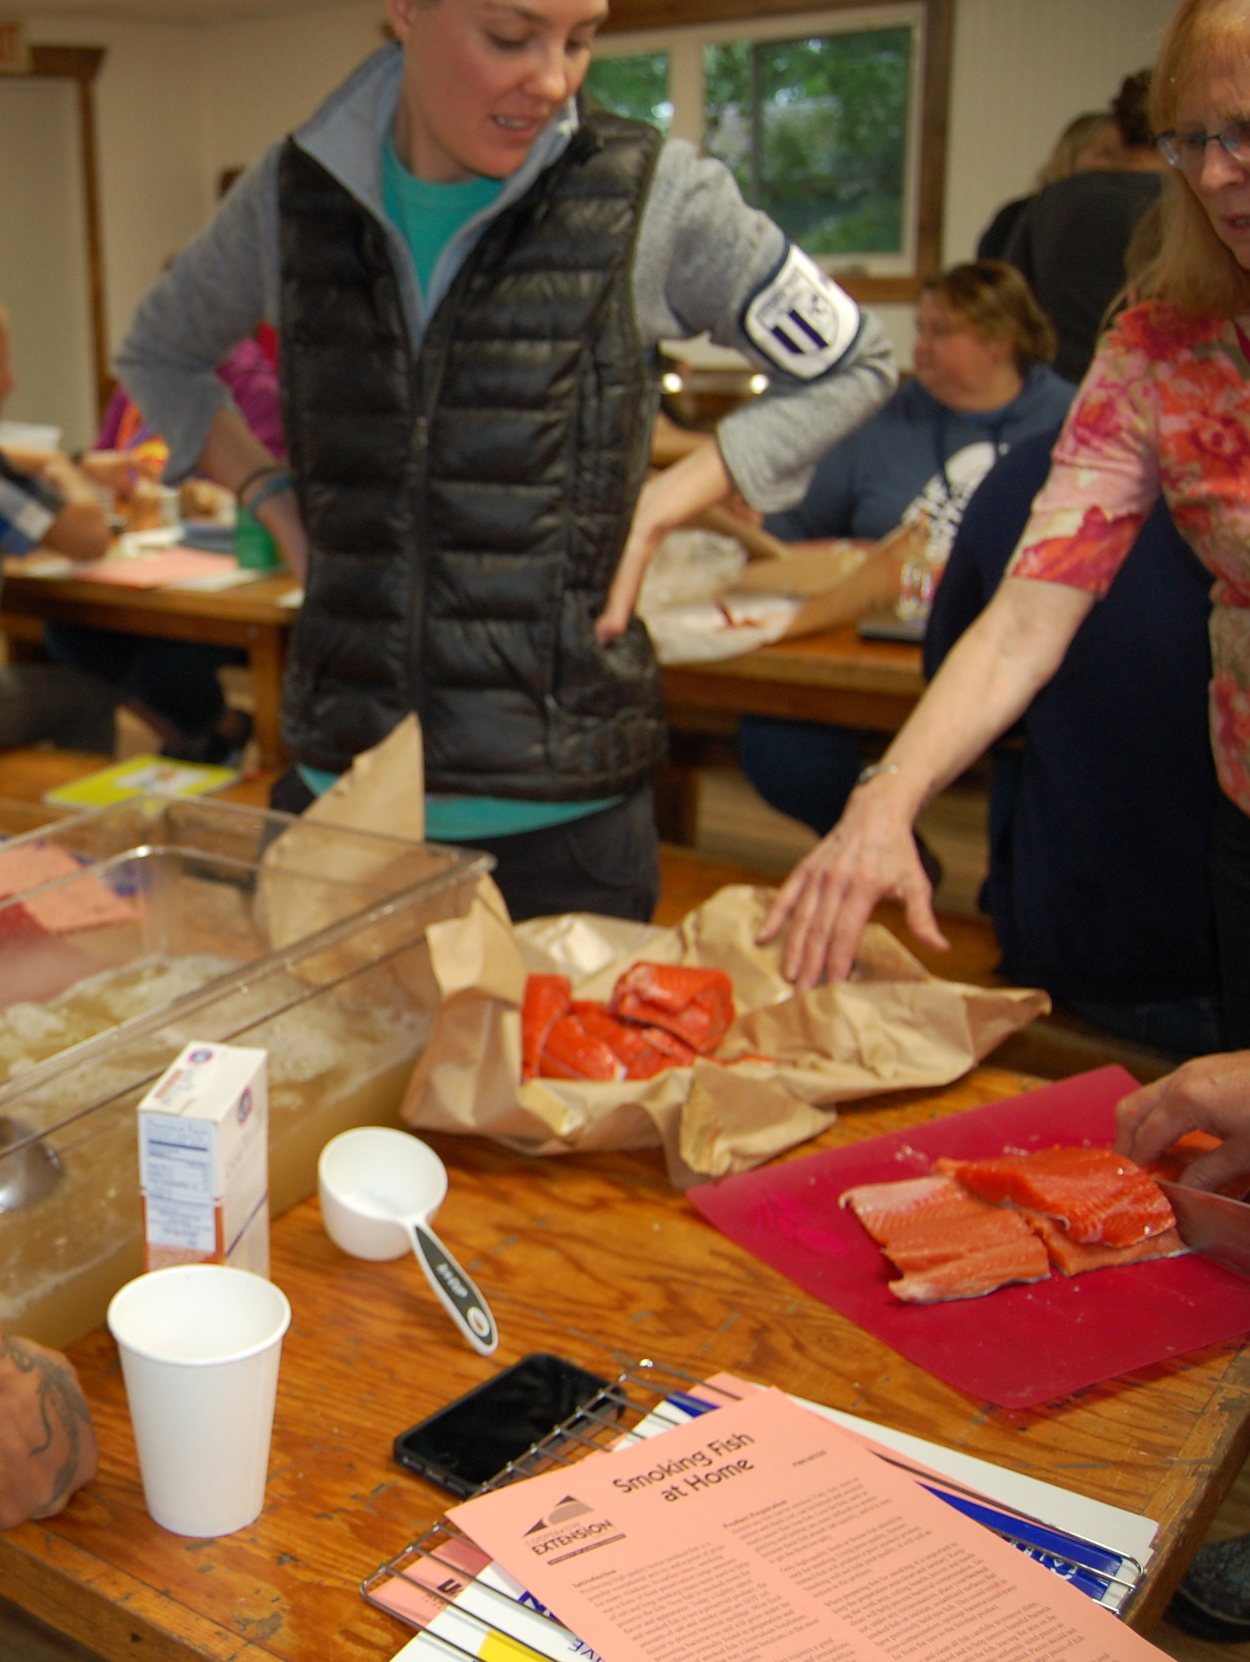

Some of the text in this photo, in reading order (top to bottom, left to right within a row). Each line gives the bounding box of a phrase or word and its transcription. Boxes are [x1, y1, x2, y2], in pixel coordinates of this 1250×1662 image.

[613, 1431, 755, 1494] Smoking Fish
[662, 1458, 754, 1502] at Home
[531, 1519, 614, 1556] EXTENSION
